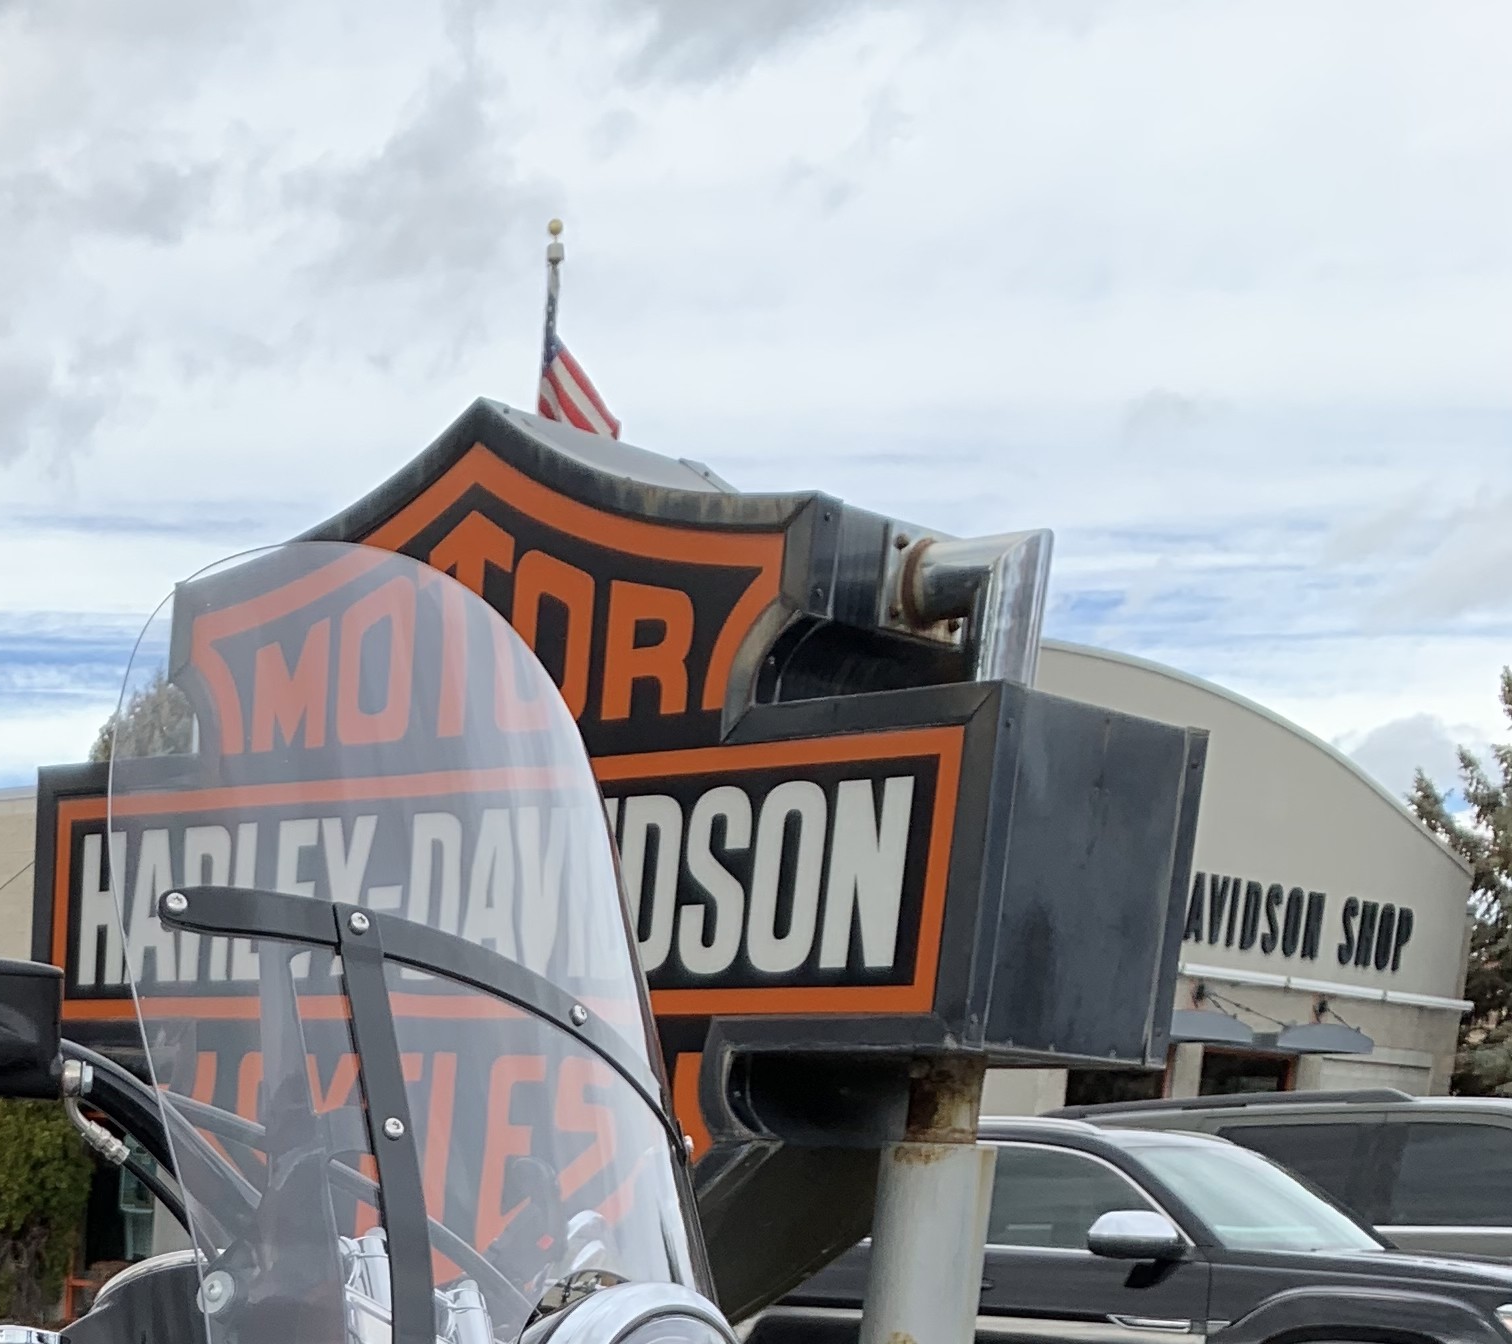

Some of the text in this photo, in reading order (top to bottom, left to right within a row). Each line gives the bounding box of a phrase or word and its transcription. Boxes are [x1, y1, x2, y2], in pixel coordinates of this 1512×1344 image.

[251, 509, 694, 753] MOTOR
[77, 776, 915, 986] HARLEY-DAVIDSON
[1337, 896, 1414, 972] SHOP
